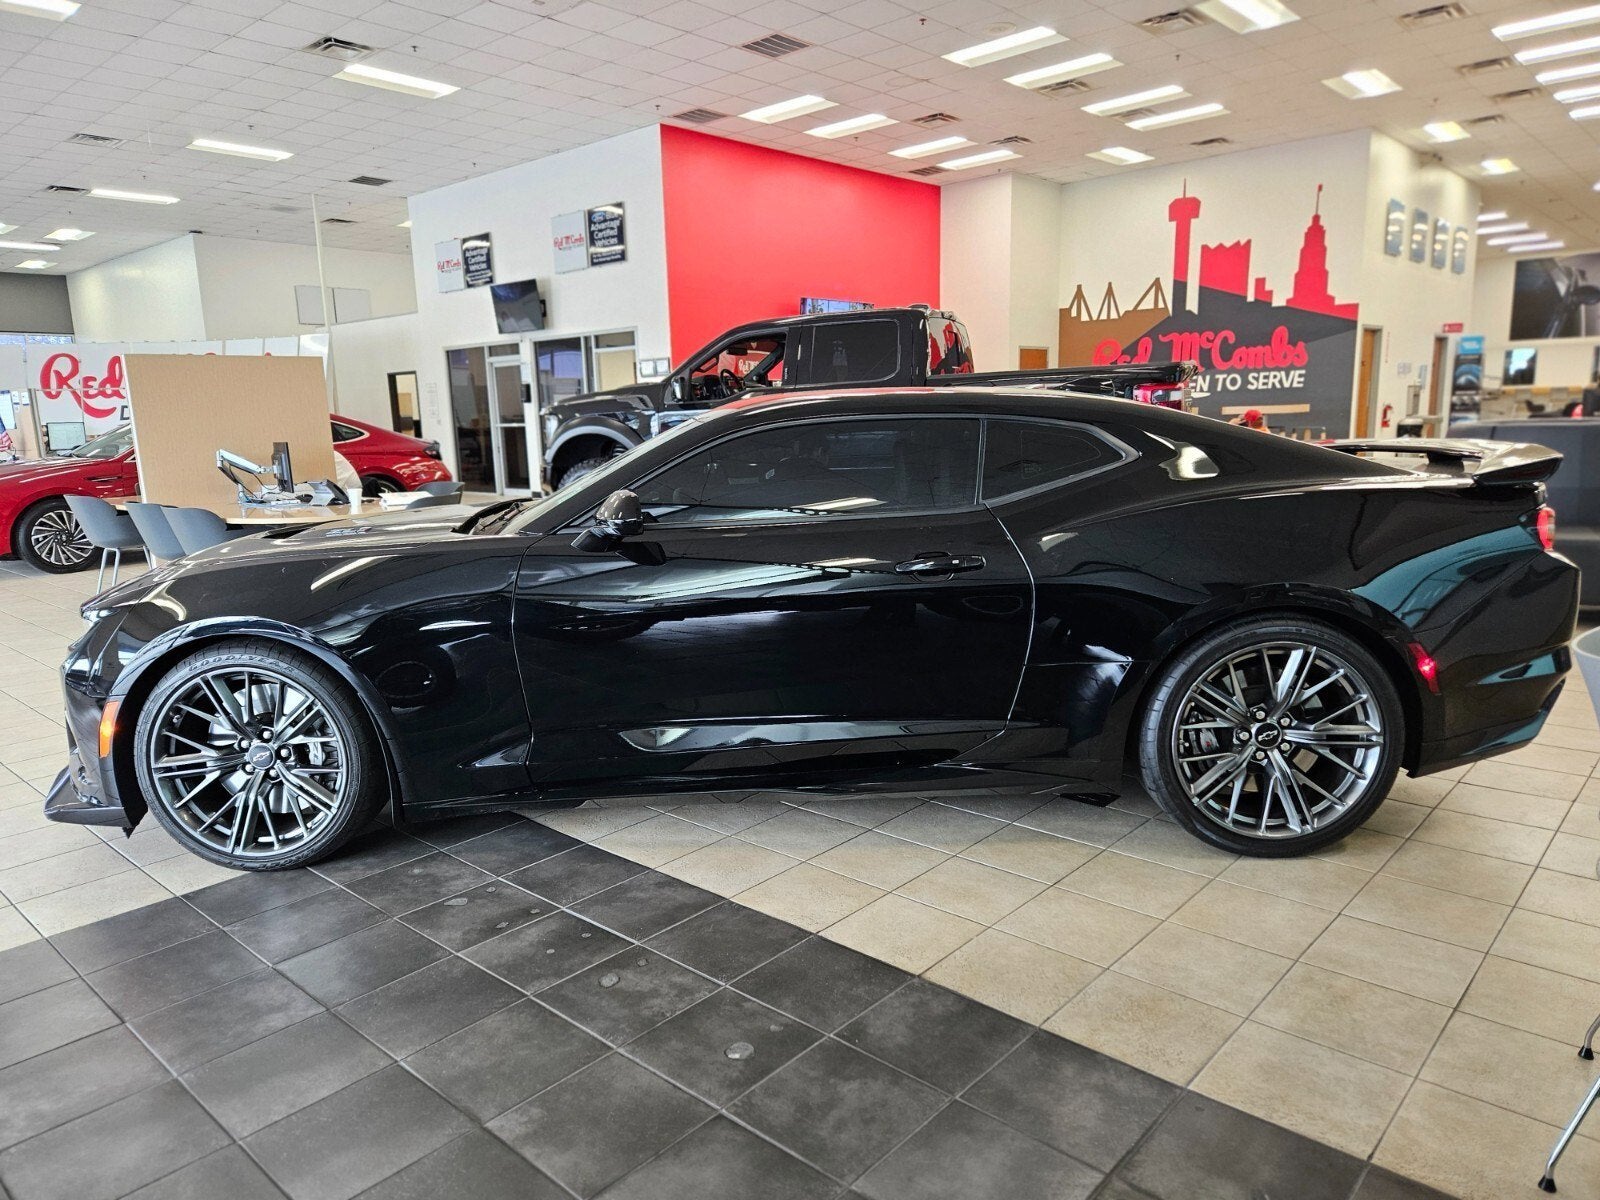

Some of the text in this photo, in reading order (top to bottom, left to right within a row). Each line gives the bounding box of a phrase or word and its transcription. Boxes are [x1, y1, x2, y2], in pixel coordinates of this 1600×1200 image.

[594, 227, 617, 240] Certified
[595, 237, 617, 247] Vehicles
[1158, 325, 1309, 372] McCombs
[40, 352, 126, 419] Red
[1215, 373, 1242, 391] TO
[1246, 369, 1306, 390] SERVE
[188, 654, 296, 673] GOODYEAR
